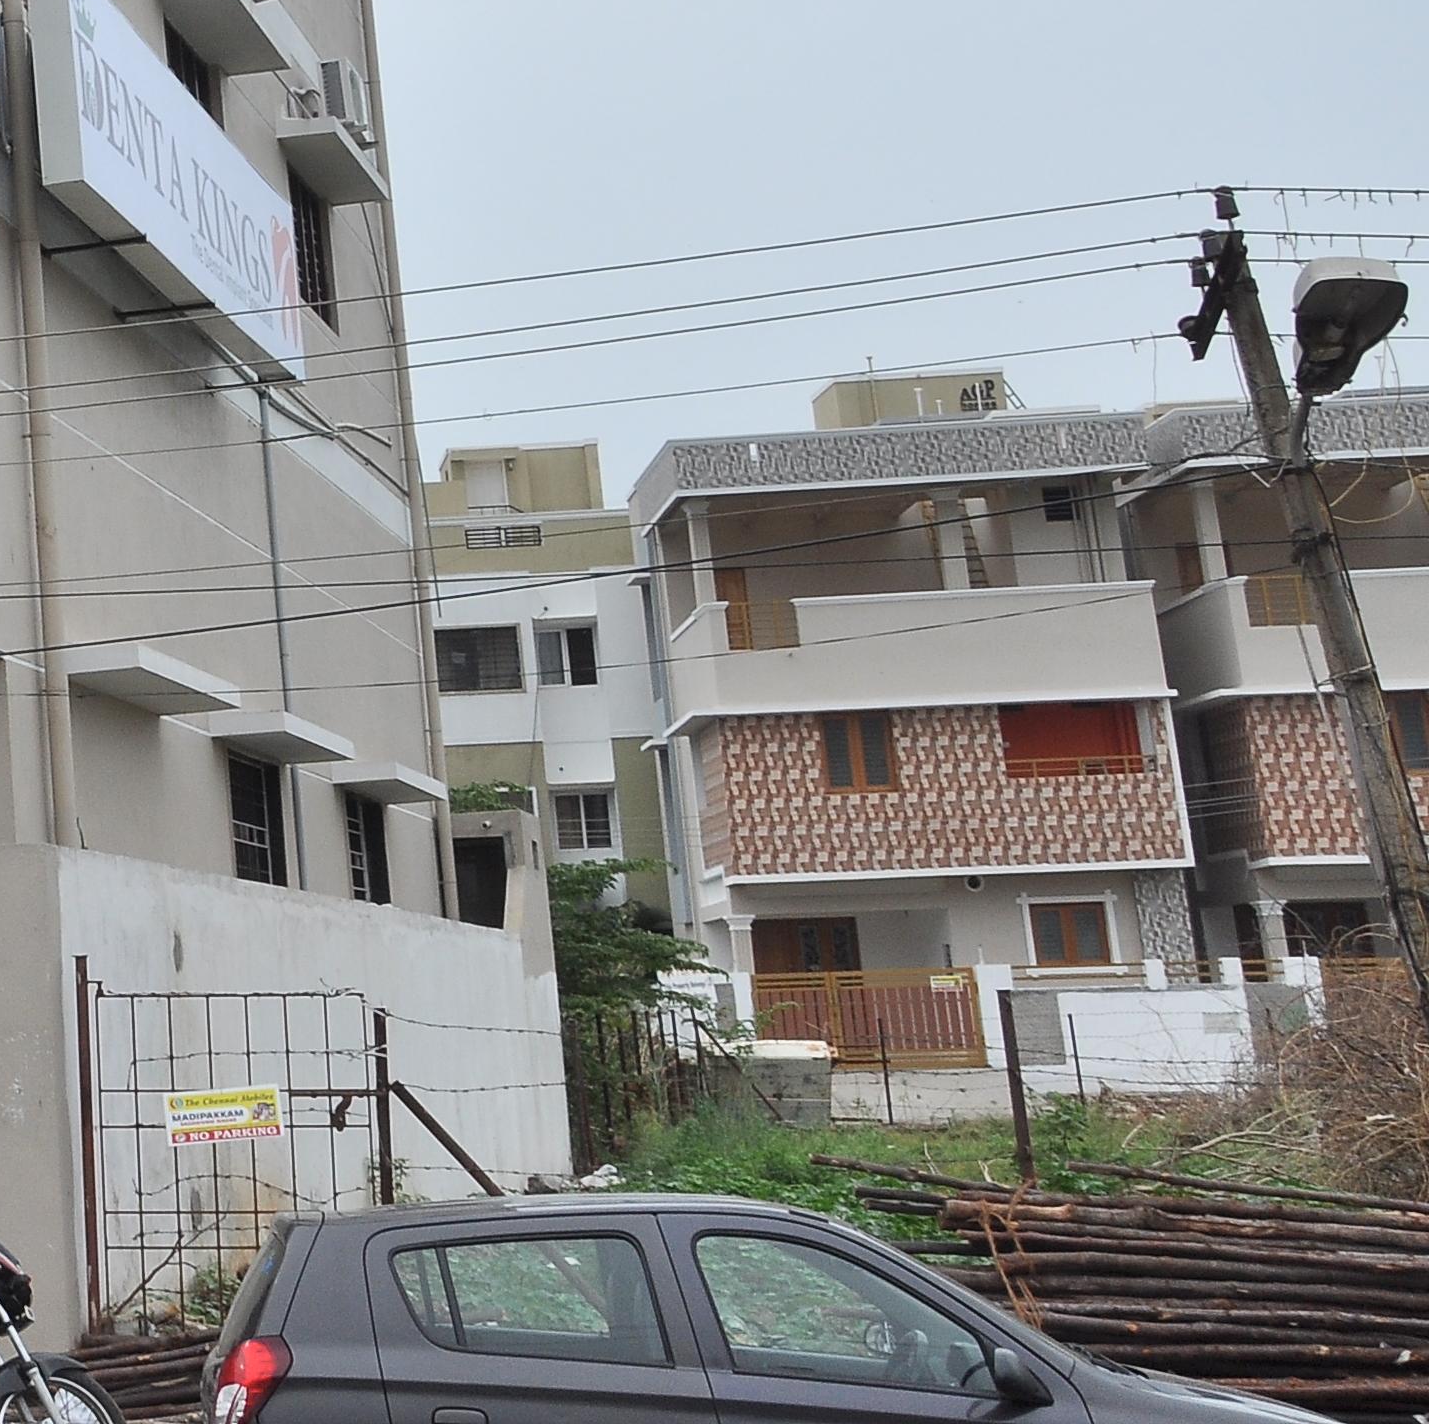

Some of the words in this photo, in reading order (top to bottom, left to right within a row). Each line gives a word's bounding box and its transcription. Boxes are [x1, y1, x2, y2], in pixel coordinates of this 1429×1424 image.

[75, 29, 189, 222] DENTA
[191, 157, 273, 304] KINGS
[172, 1109, 245, 1122] MADIPAKKAM
[188, 1131, 211, 1142] NO
[212, 1125, 278, 1139] PARKING
